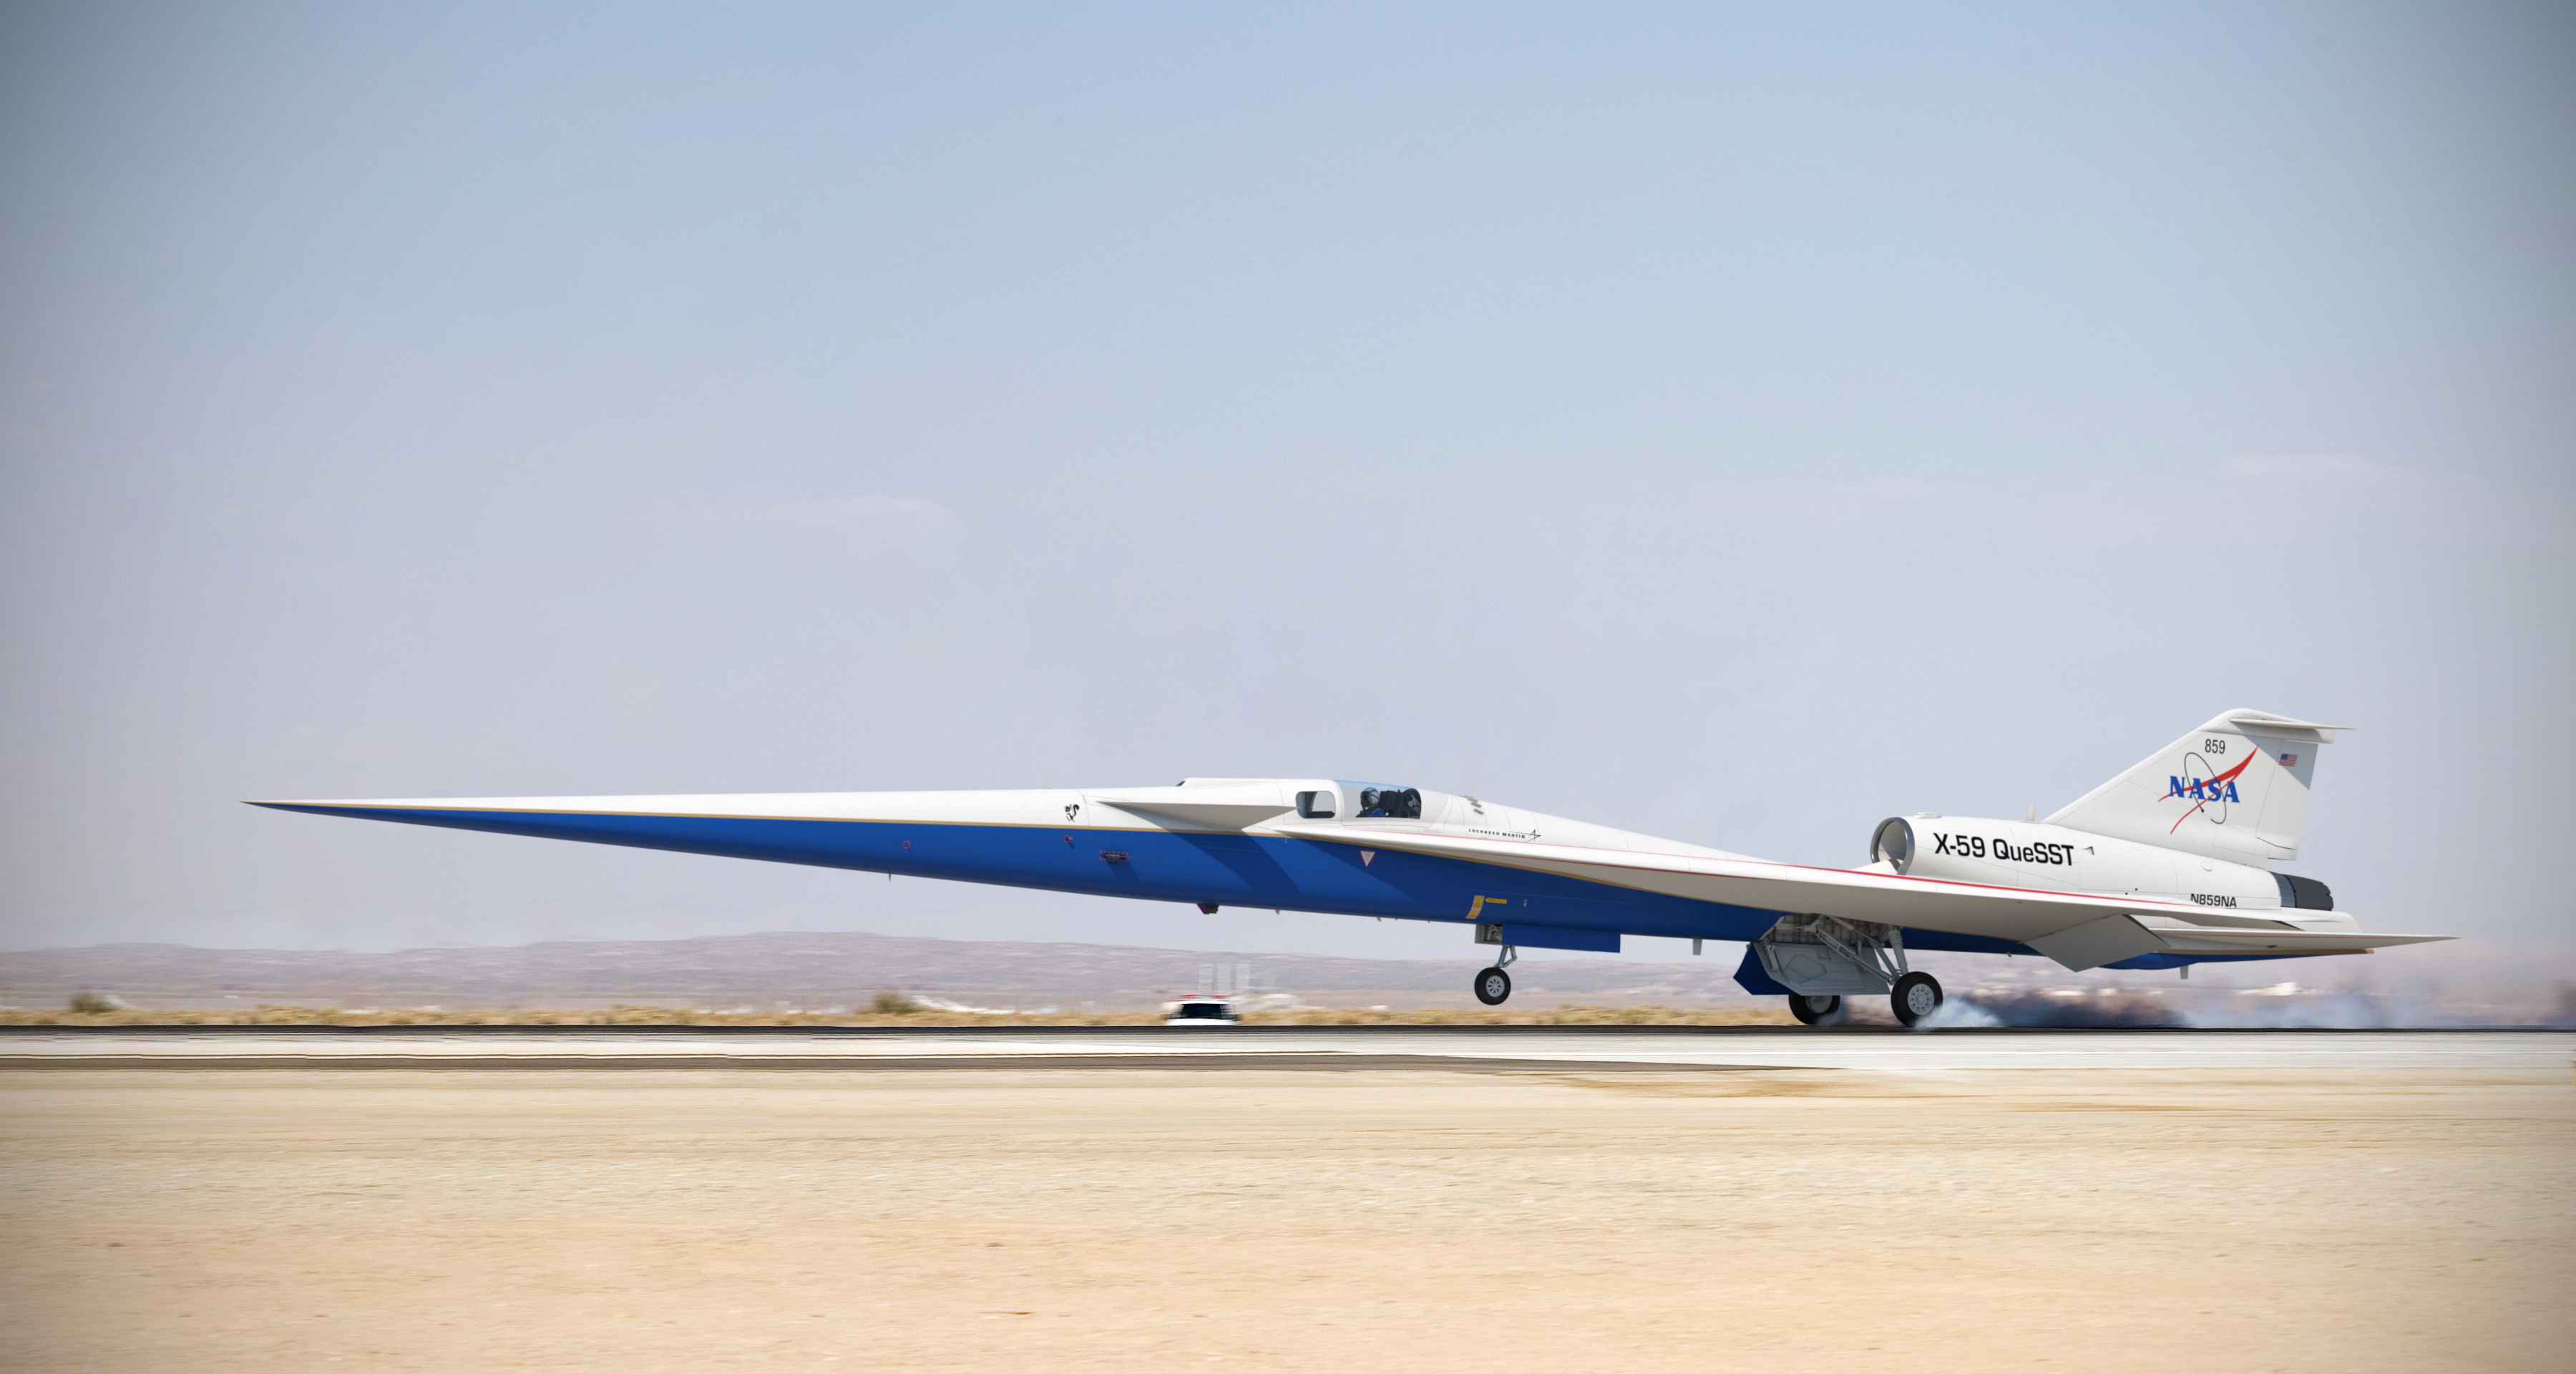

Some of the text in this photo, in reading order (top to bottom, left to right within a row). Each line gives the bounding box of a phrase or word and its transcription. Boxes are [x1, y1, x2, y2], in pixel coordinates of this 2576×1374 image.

[2205, 739, 2225, 754] 859
[2170, 775, 2240, 803] NASA
[1933, 832, 2074, 866] X-59 QueSST
[2190, 893, 2237, 908] N859NA
